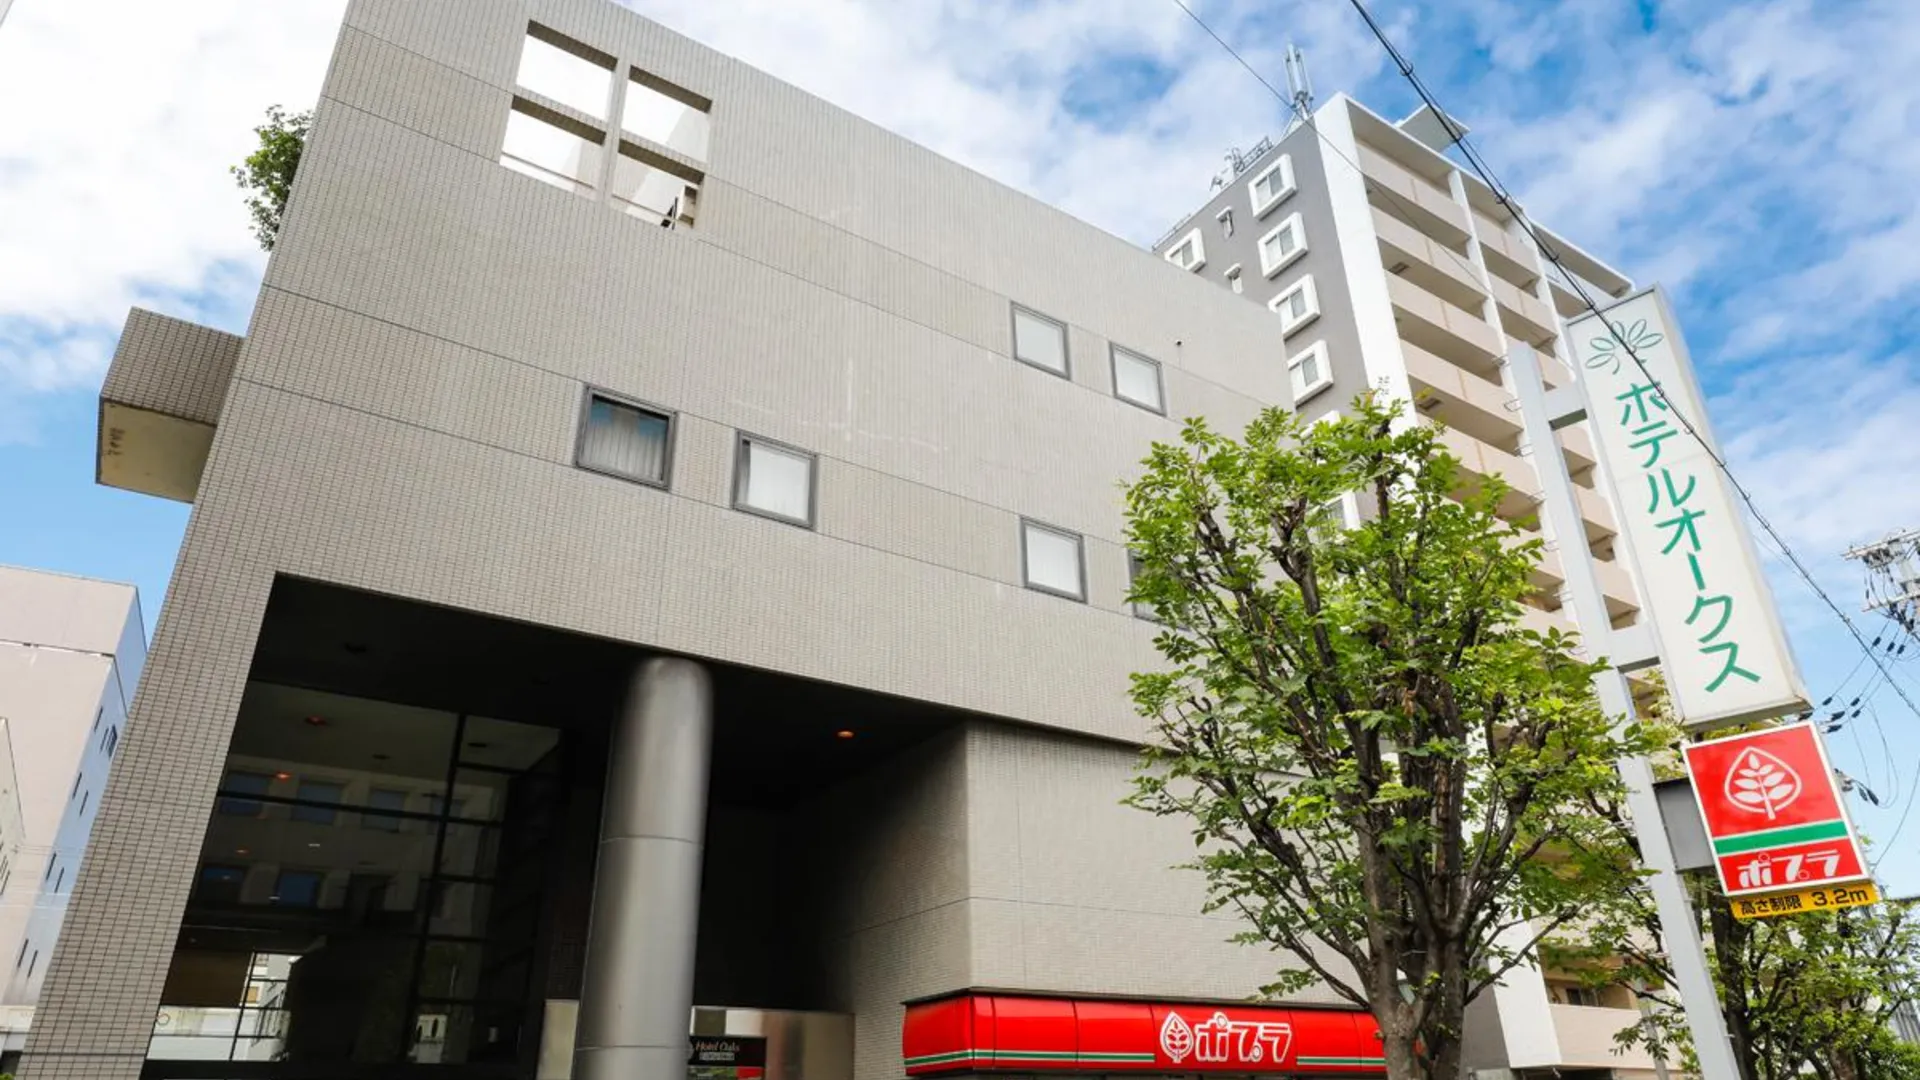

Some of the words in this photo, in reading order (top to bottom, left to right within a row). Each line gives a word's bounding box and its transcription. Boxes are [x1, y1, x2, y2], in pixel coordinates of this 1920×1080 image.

[1615, 381, 1761, 693] ホテルオークス
[1737, 850, 1840, 888] ポプラ
[1741, 894, 1803, 915] 高さ制限
[1811, 887, 1869, 907] 3.2m
[1194, 1011, 1292, 1063] ポプラ
